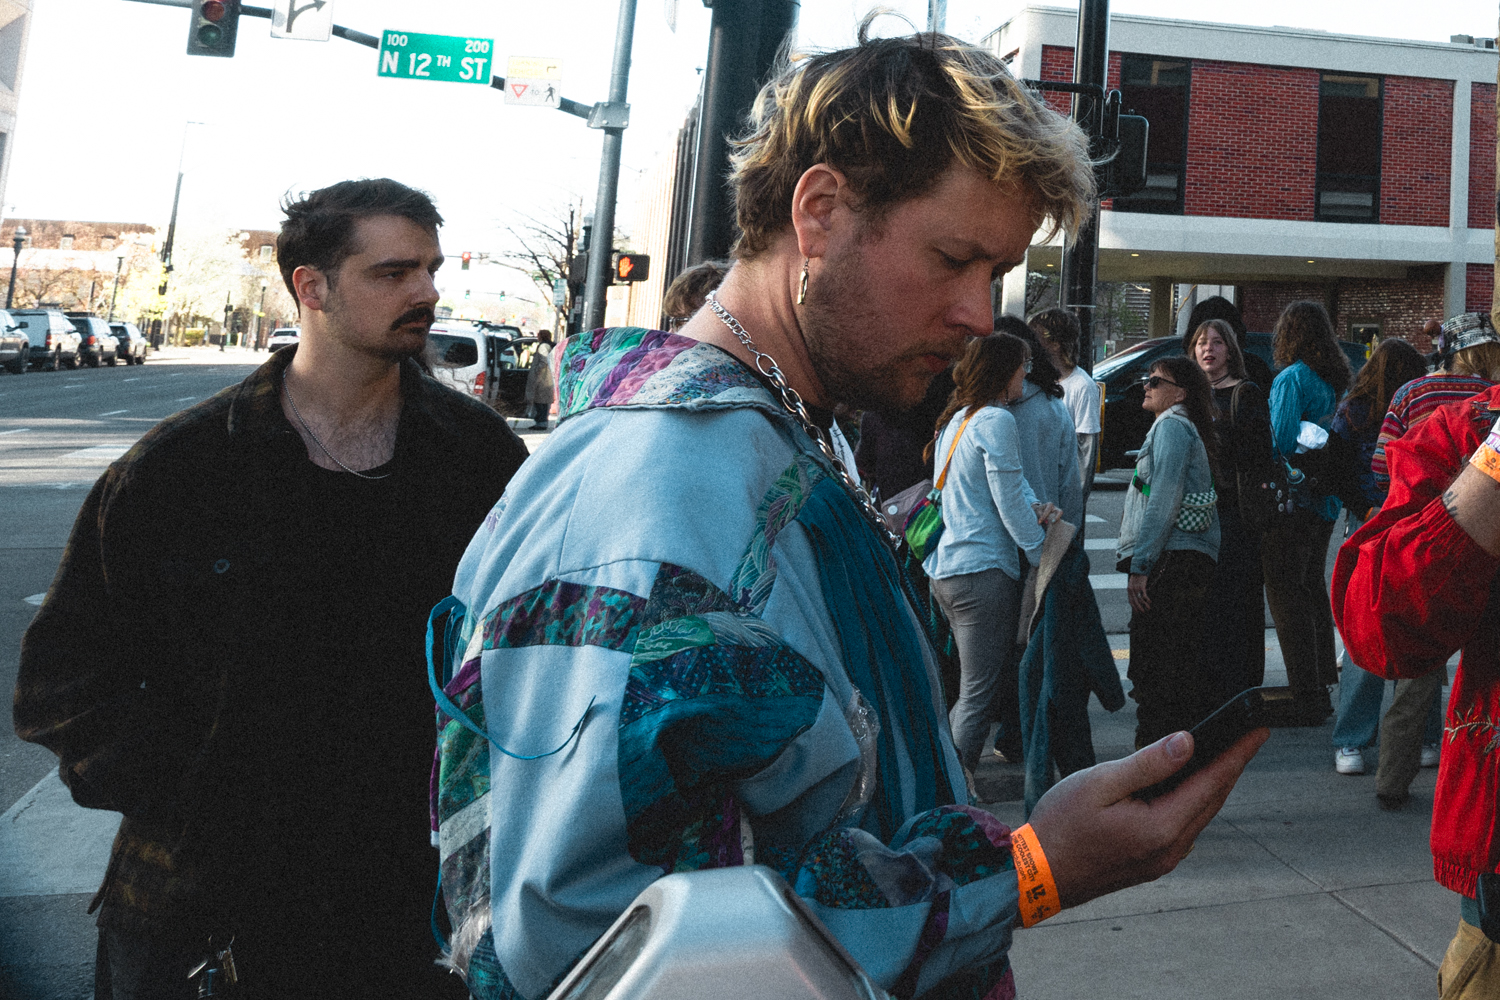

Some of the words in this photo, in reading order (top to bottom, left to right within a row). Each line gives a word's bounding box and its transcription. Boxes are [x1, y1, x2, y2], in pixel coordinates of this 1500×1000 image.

[387, 33, 409, 47] 100
[464, 39, 490, 54] 200
[381, 50, 400, 74] N
[458, 56, 488, 80] ST
